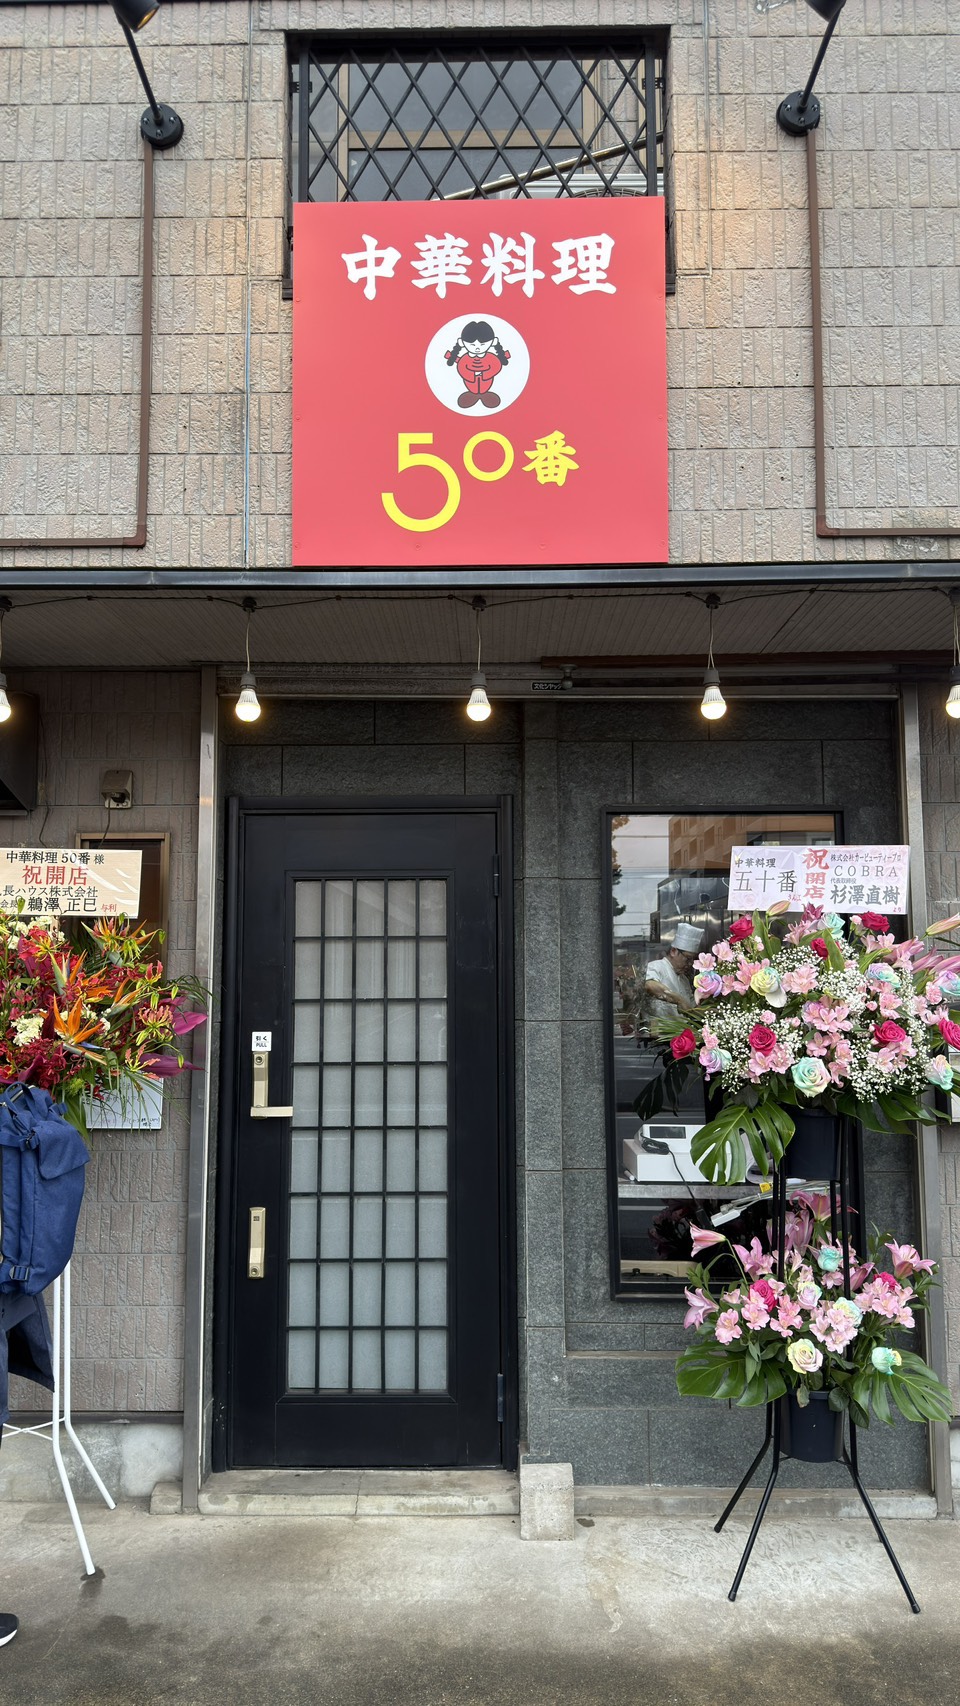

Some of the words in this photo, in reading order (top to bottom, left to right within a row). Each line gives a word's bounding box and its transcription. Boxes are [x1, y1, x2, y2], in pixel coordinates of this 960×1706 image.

[341, 231, 617, 300] 中華料理
[381, 430, 580, 532] 50番
[6, 850, 58, 864] 中華料理
[61, 851, 91, 865] 50番
[94, 854, 105, 865] 様
[735, 857, 776, 868] 中華料理
[22, 864, 89, 886] 祝開店
[733, 870, 798, 893] 五十番
[802, 848, 830, 899] 祝開店
[834, 865, 898, 877] COBRA
[0, 885, 98, 898] 長ハウス株式会社
[830, 884, 901, 906] 杉澤直樹
